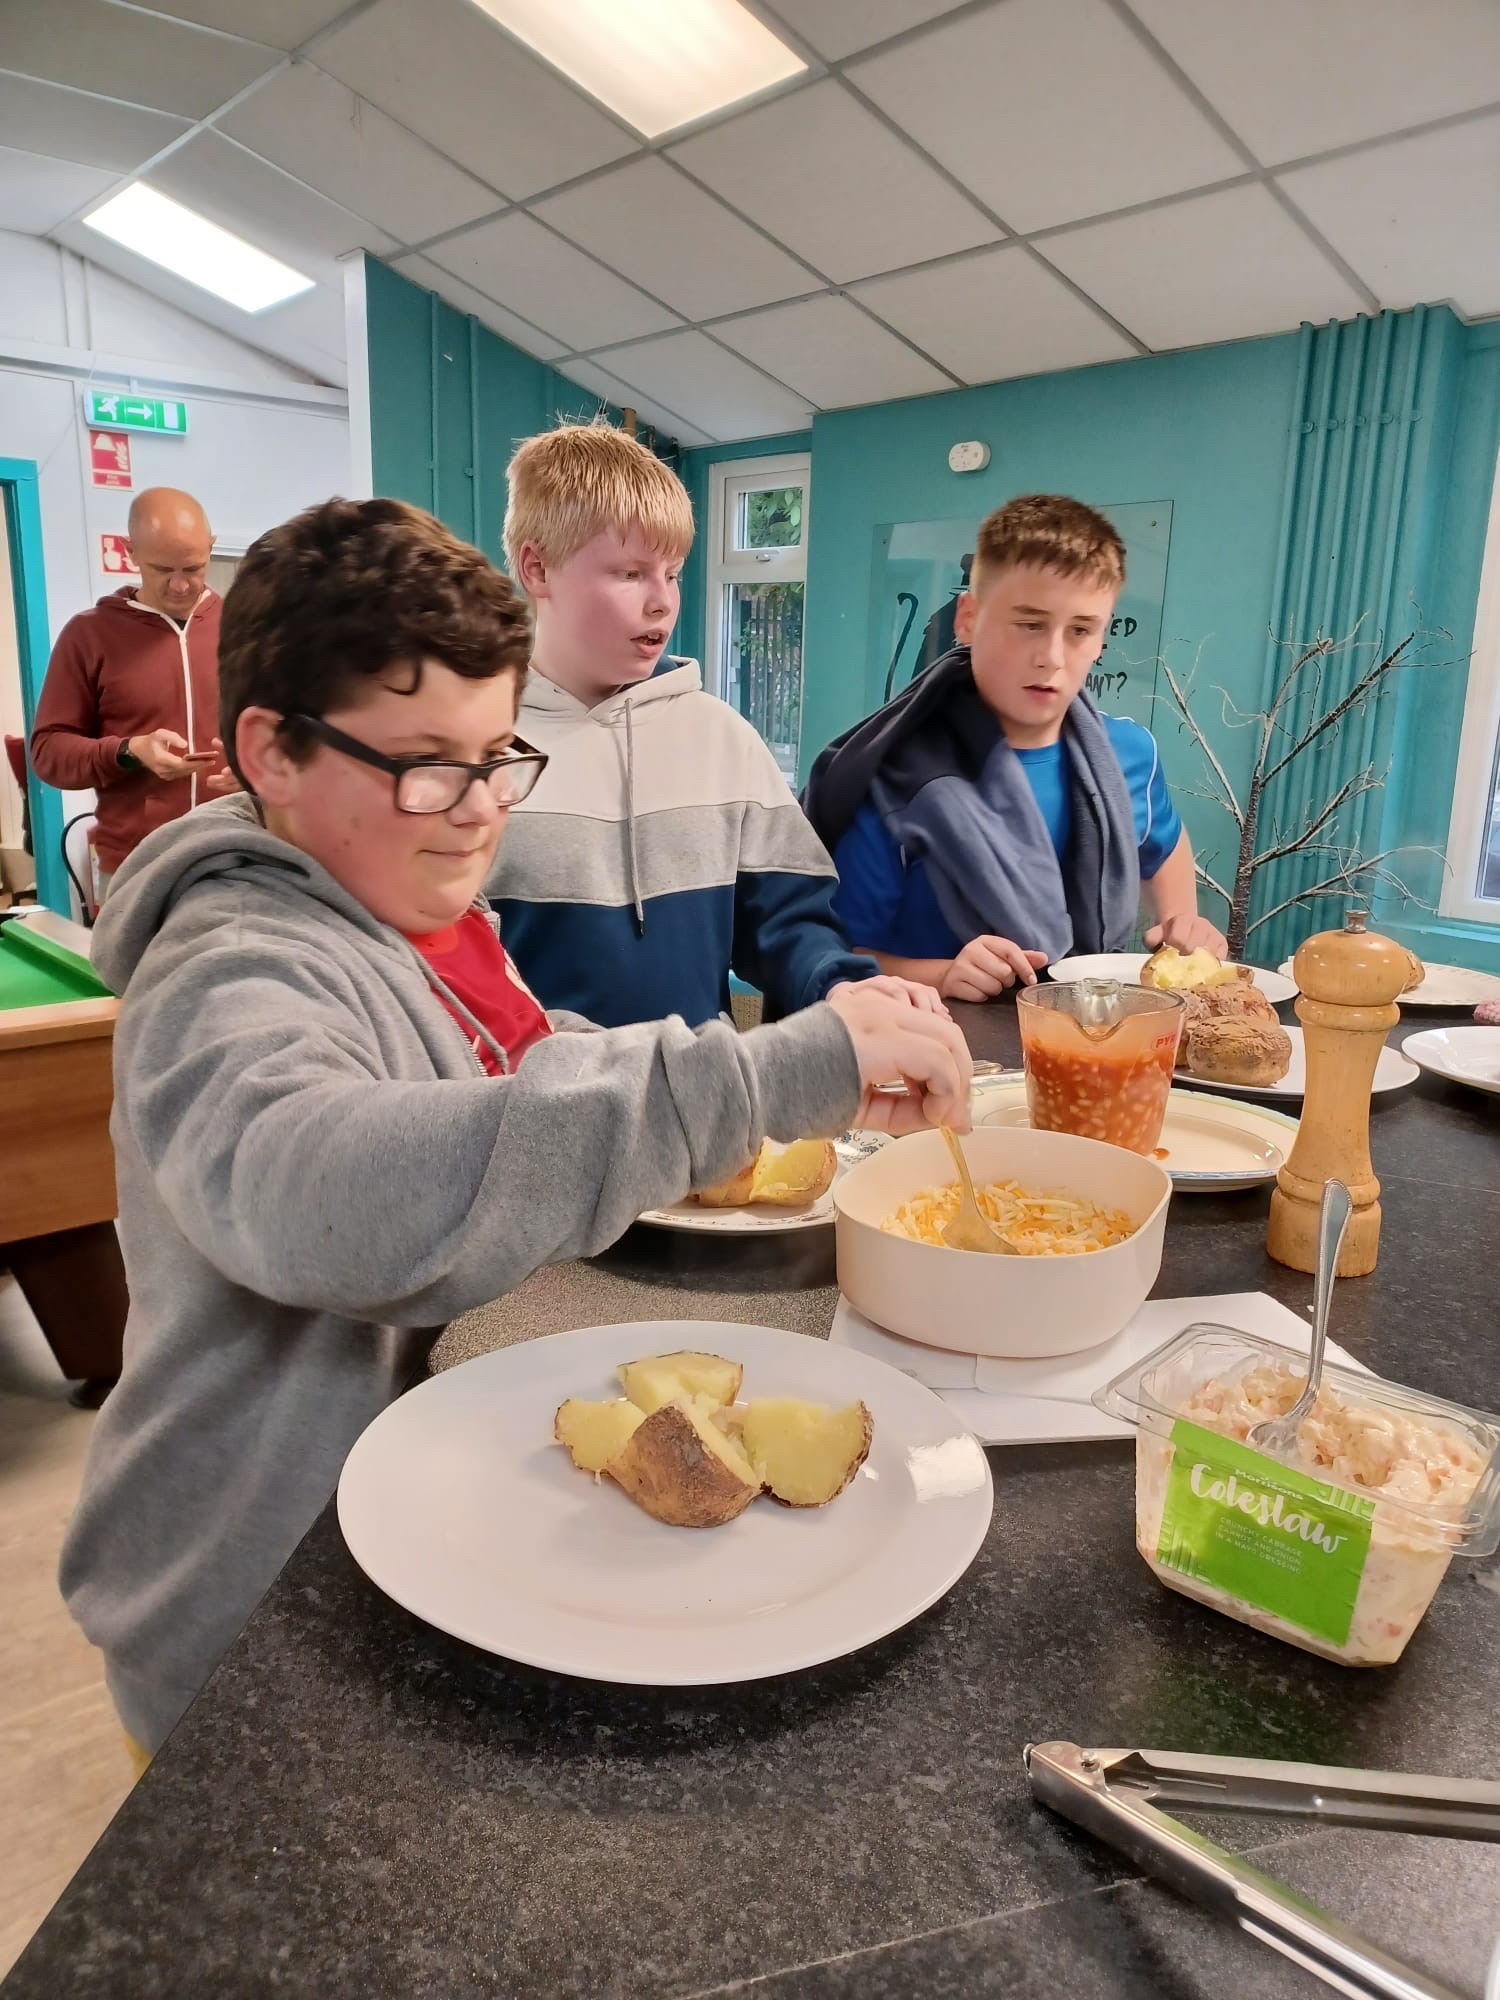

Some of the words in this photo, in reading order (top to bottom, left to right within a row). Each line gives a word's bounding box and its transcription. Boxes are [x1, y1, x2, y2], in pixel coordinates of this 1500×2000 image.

[1105, 614, 1137, 637] ED
[1085, 671, 1128, 700] ANT?
[1235, 1468, 1304, 1500] Morrisons
[1190, 1463, 1349, 1554] Coleslaw
